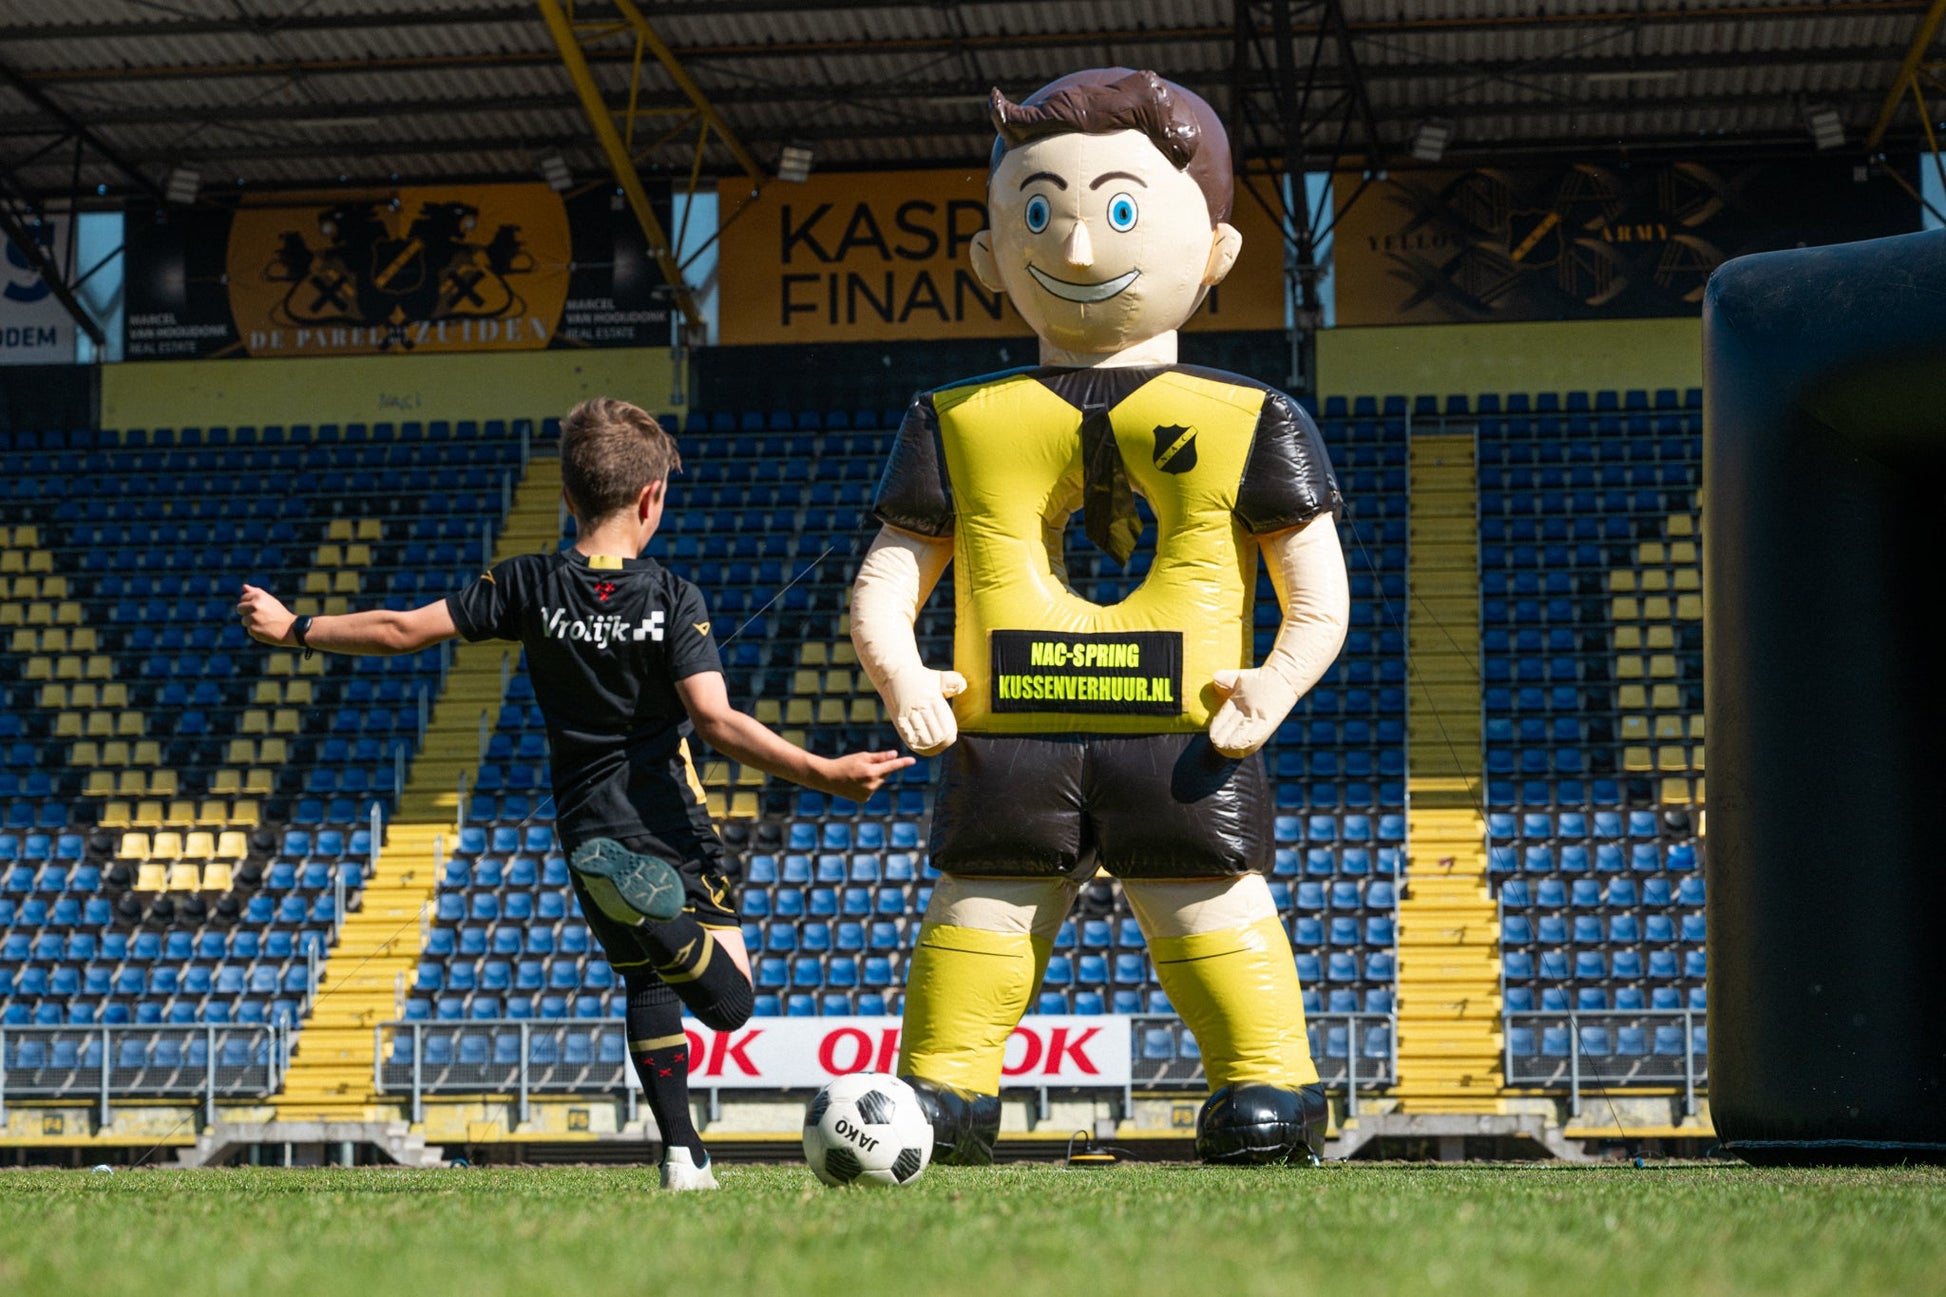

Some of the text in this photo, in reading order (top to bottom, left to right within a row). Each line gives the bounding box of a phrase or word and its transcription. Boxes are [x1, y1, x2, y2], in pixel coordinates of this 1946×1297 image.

[781, 199, 990, 263] KASP
[781, 269, 1004, 326] FINAN
[249, 329, 285, 350] DE
[296, 326, 384, 349] PAREL
[414, 317, 548, 345] ZUIDEN
[541, 607, 630, 649] Vrolijk
[1030, 641, 1140, 668] NAC-SPRING
[998, 674, 1174, 702] KUSSENVERHUUR.NL
[1002, 1028, 1103, 1076] OK
[835, 1119, 880, 1153] JAKO
